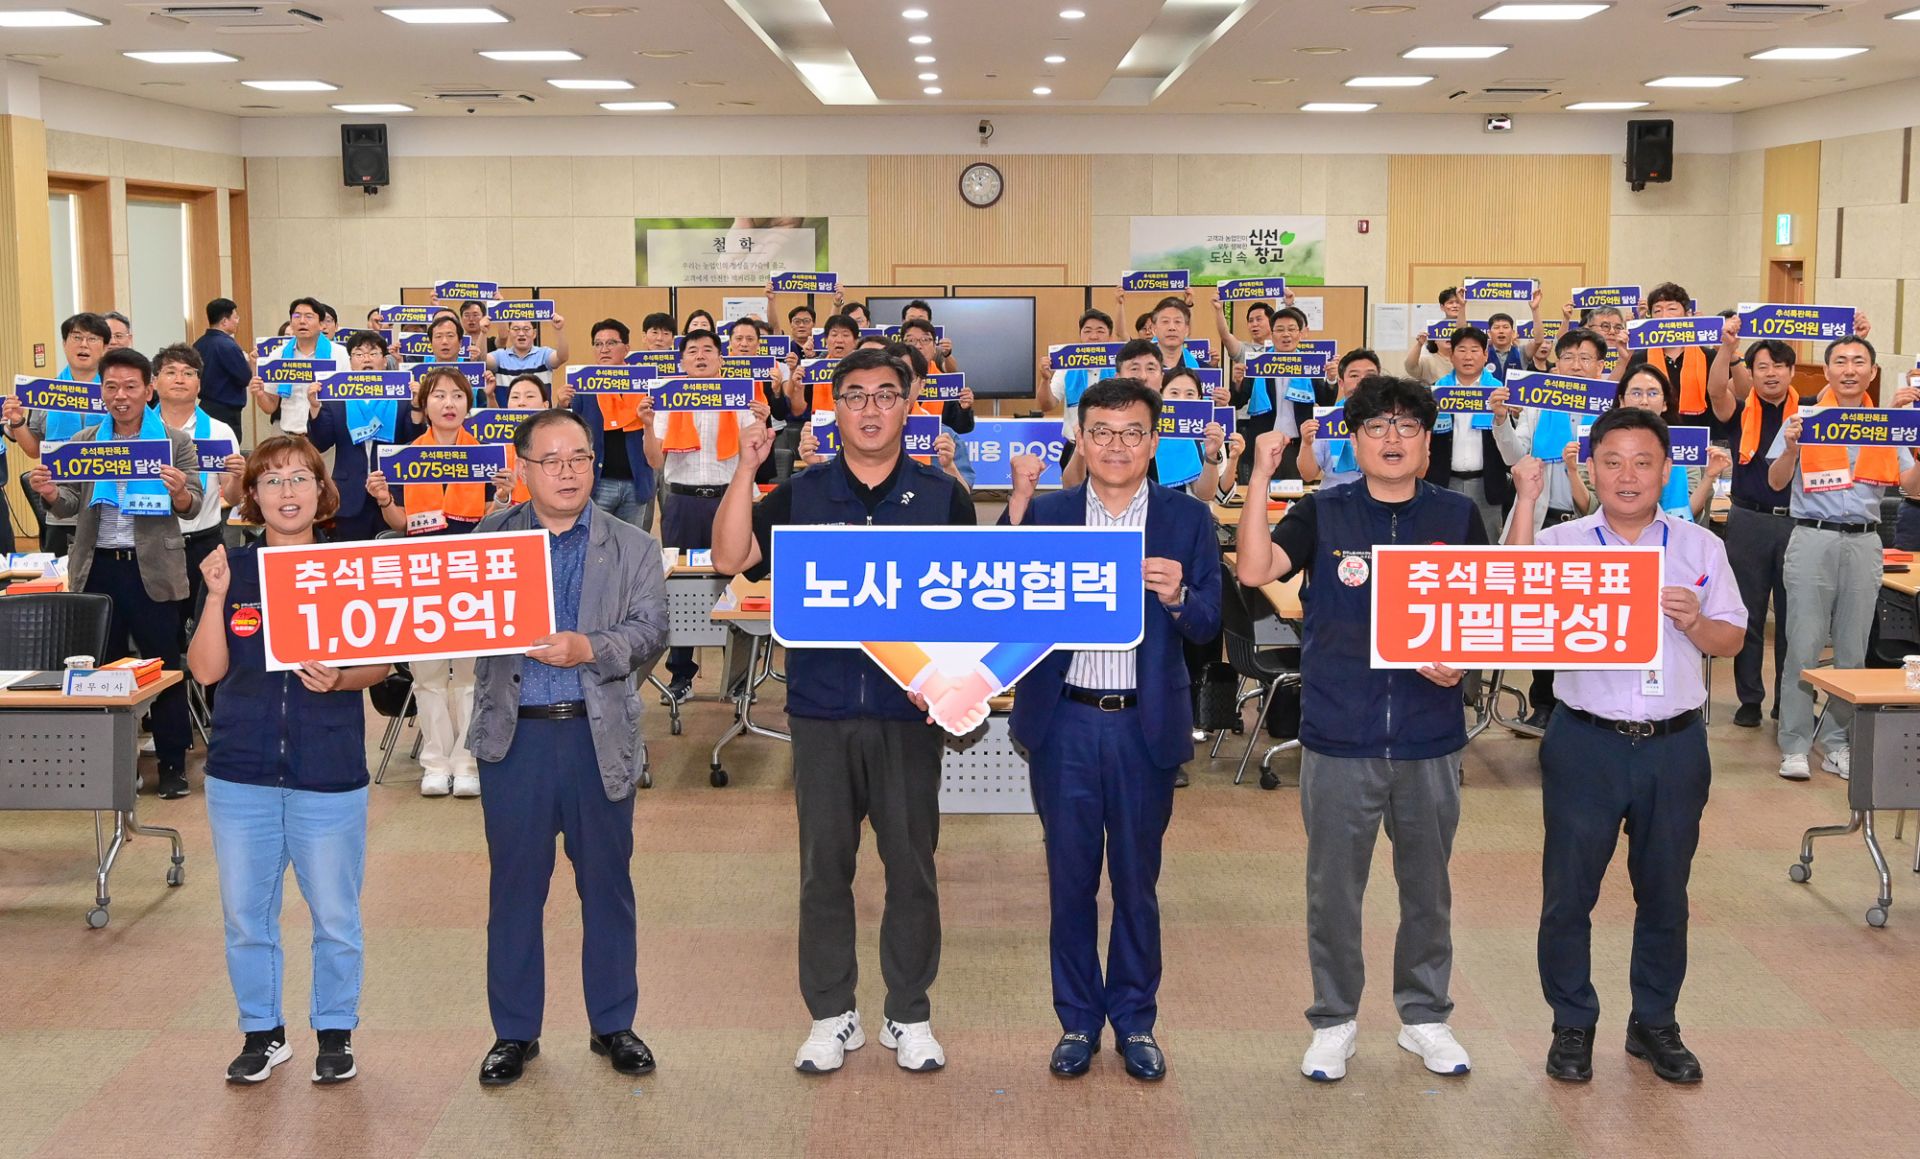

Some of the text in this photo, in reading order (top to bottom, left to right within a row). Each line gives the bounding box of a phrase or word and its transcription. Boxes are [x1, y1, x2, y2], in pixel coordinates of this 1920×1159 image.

[1249, 228, 1278, 246] 신선
[1210, 247, 1284, 265] 도심 속 창고
[778, 280, 833, 291] 1,075억원 달성
[1129, 279, 1184, 289] 1,075억원 달성
[441, 288, 493, 299] 1,075억원 달성
[1224, 287, 1280, 299] 1,075억원 달성
[1472, 288, 1528, 299] 1,075억원 달성
[1580, 295, 1636, 306] 1,075억원 달성
[387, 313, 426, 322] 1,075억원
[494, 309, 550, 320] 1,075억원 달성
[1776, 309, 1819, 319] 추석특판목표
[1434, 328, 1456, 338] 1,07
[1750, 318, 1846, 336] 1,075억원 달성
[1638, 329, 1718, 345] 1,075억원 달성
[406, 342, 433, 353] 1,075
[770, 346, 785, 355] 달성
[1058, 354, 1107, 368] 1,075억원
[265, 369, 313, 381] 1,075억원
[722, 367, 770, 378] 75억원 달성
[810, 370, 833, 381] 1,07
[1254, 363, 1321, 375] 1,075억원 달성
[576, 377, 630, 390] 1,075억원
[682, 383, 722, 391] 추석특판목표
[1543, 378, 1587, 391] 추석특판목표
[327, 384, 405, 397] 1,075억원 달성
[939, 386, 959, 397] 달성
[25, 390, 89, 410] 1,075억원
[660, 392, 746, 408] 1,075억원 달성
[1435, 397, 1483, 411] ,075억원
[1518, 386, 1586, 410] 1,075억원
[1840, 412, 1889, 422] 추석특판목표
[471, 423, 516, 441] 1,075
[1178, 419, 1204, 434] 달성
[1811, 422, 1918, 442] 1,075억원 달성
[904, 434, 931, 449] 달성
[80, 447, 130, 456] 추석특판목표
[420, 451, 467, 460] 추석특판목표
[1671, 446, 1699, 461] 달성
[52, 458, 162, 478] 1,075억원 달성
[393, 462, 498, 480] 1,075억원 달성
[295, 547, 518, 595] 추석특판목표
[1407, 560, 1631, 596] 추석특판목표
[802, 560, 1117, 612] 노사 상생협력
[298, 589, 517, 653] 1,075억!
[1407, 603, 1631, 653] 기필달성!
[74, 682, 124, 693] 전무이사
